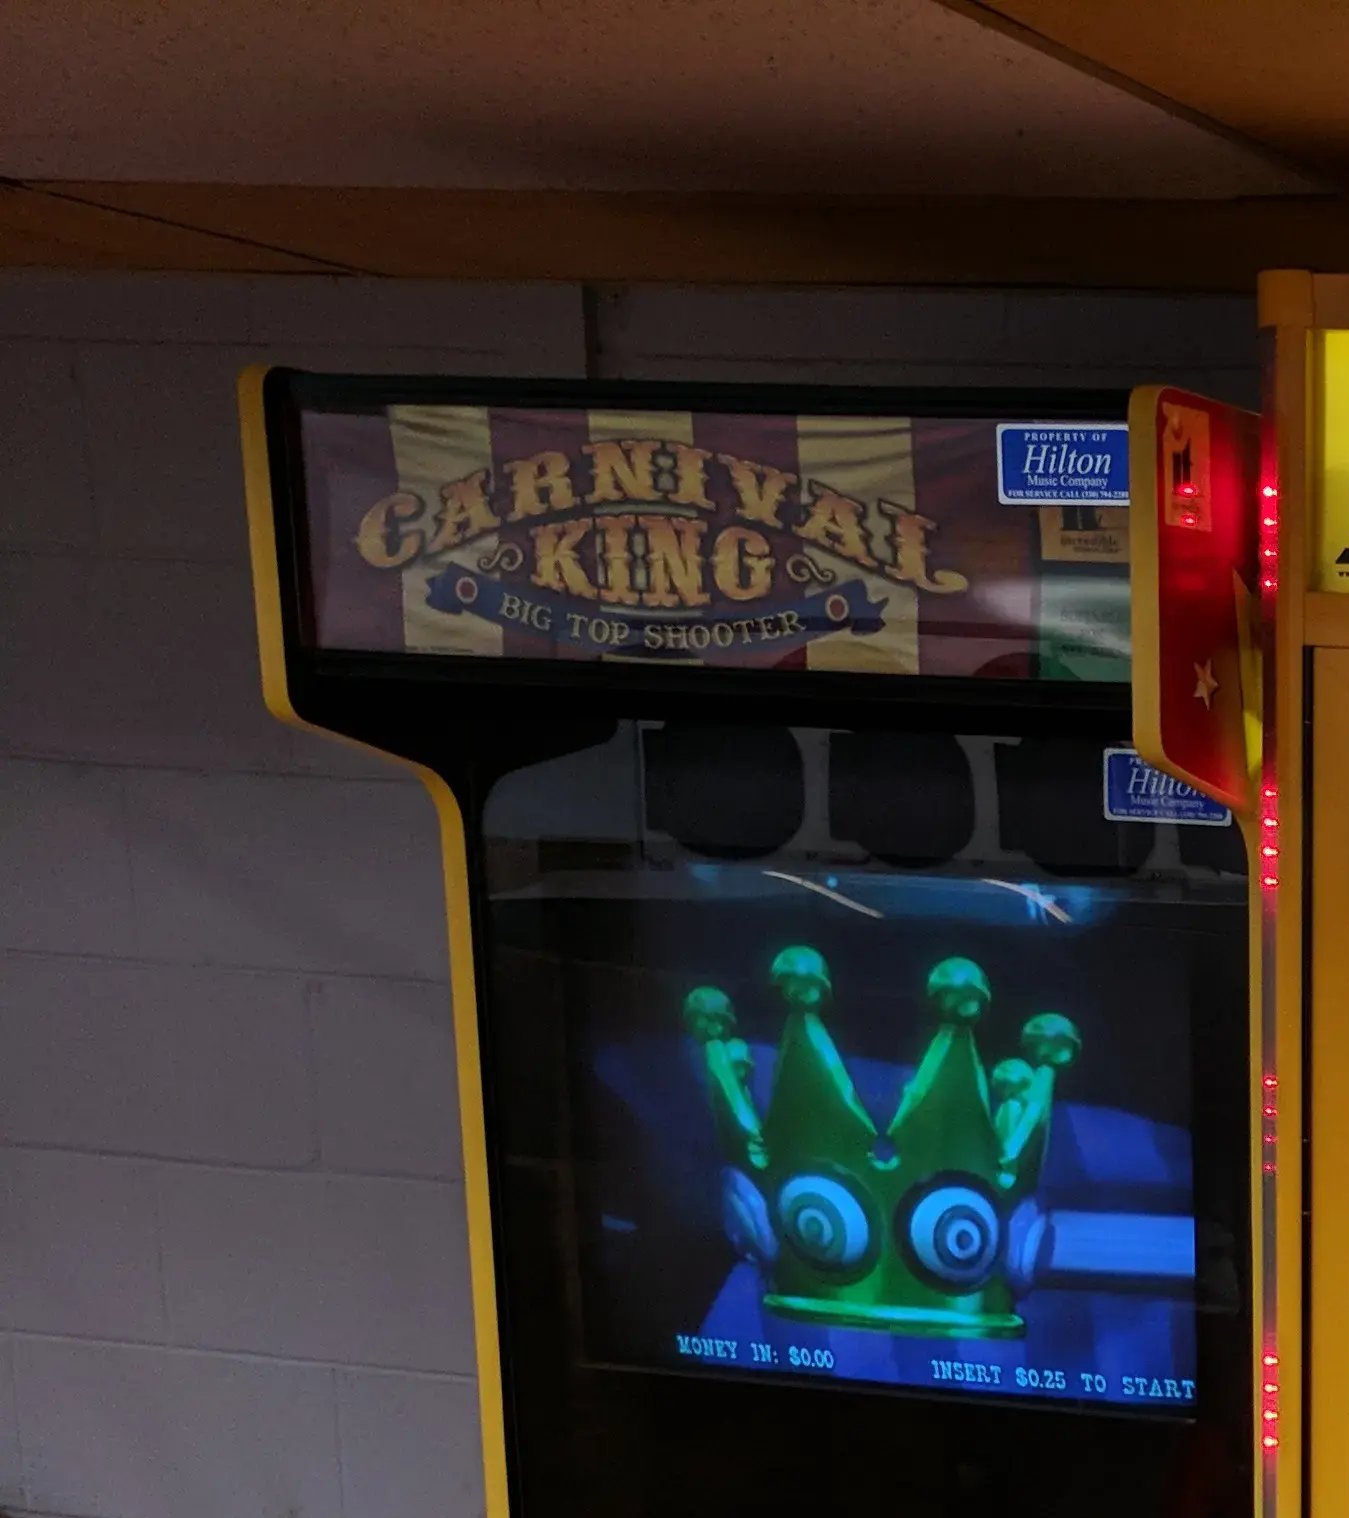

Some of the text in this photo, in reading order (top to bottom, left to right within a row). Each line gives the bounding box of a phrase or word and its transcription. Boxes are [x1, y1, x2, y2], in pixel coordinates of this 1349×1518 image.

[1024, 432, 1108, 442] PROPERTY OF
[1021, 443, 1112, 475] Hilton
[1027, 475, 1109, 490] Music Company
[355, 440, 969, 594] CARNIVAL
[529, 514, 775, 608] KING
[499, 592, 806, 651] BIG TOP SHOOTER
[1127, 767, 1206, 797] Hilto
[677, 1334, 835, 1370] MONEY IN: $0.00
[931, 1358, 1197, 1400] INSERT $0.25 TO START
